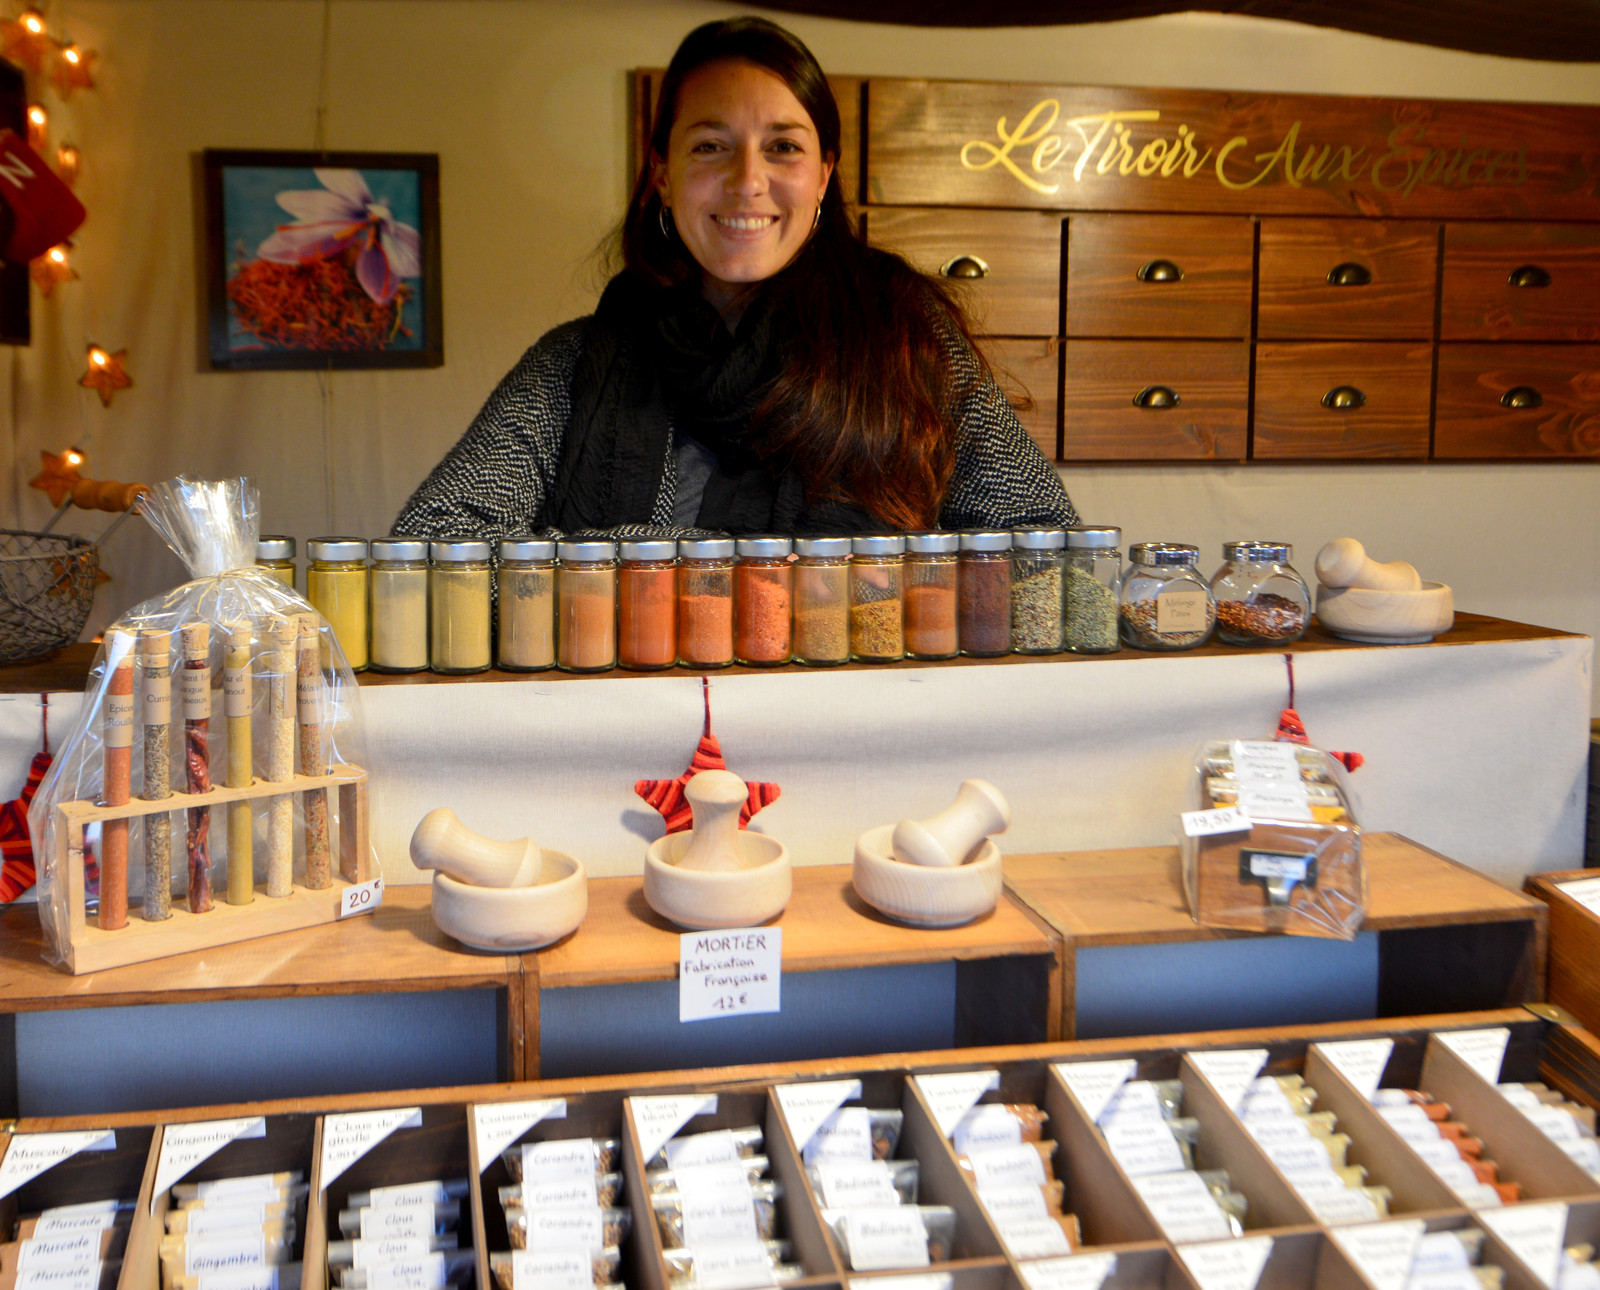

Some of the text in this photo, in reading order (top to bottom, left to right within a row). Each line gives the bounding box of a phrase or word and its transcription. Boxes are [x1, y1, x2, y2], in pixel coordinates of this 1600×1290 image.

[960, 98, 1067, 195] Le
[1066, 109, 1215, 183] Tiroir
[1214, 121, 1371, 190] Aux
[349, 879, 381, 908] 20 €
[683, 956, 755, 974] Fabrication
[704, 973, 768, 988] Française
[166, 1131, 236, 1147] Gingembre
[10, 1145, 73, 1160] Muscade
[45, 1214, 101, 1231] Muscade
[32, 1235, 89, 1257] Muscade
[193, 1252, 259, 1271] Gingembre
[29, 1264, 90, 1283] Muscade
